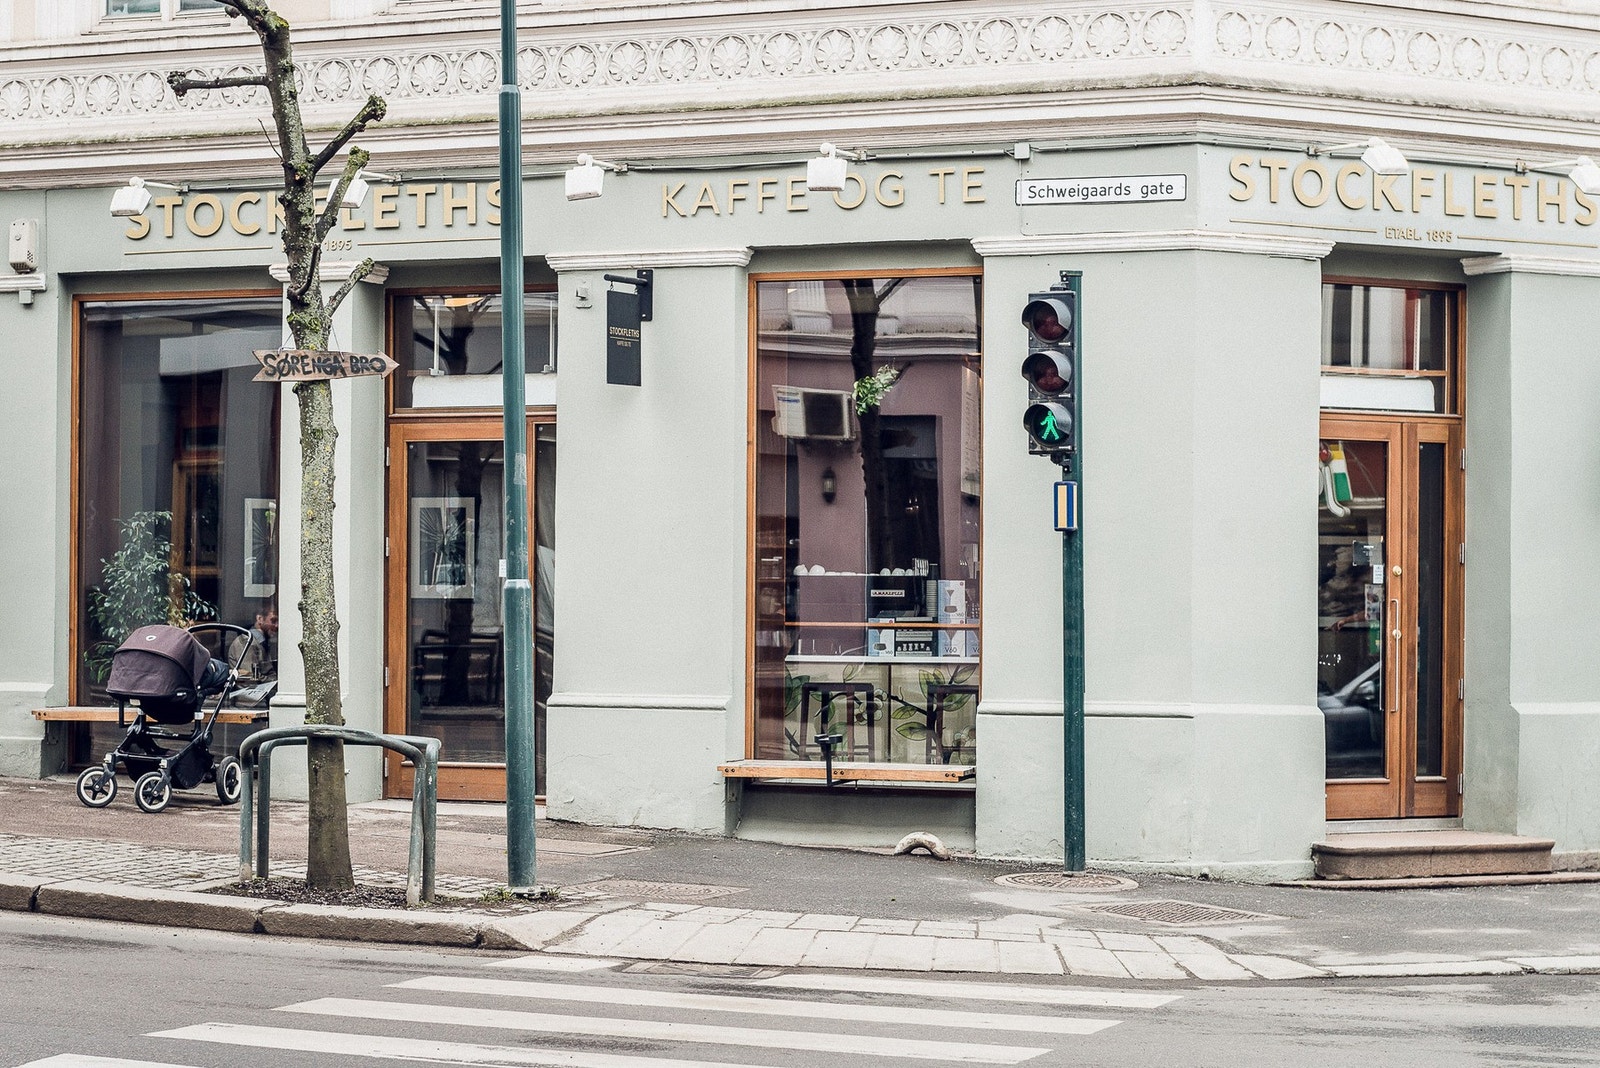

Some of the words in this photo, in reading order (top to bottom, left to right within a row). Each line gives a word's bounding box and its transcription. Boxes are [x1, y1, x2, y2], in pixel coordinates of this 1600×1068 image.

[662, 176, 809, 217] KAFFE
[832, 170, 904, 210] OG
[929, 166, 986, 205] TE
[1028, 183, 1131, 200] Schweigaards
[1140, 182, 1174, 198] gate
[1229, 155, 1598, 225] STOCKFLETHS
[1385, 226, 1422, 241] ETABL.
[1426, 228, 1453, 243] 1895
[324, 240, 352, 251] 1895
[350, 356, 387, 374] BRO
[944, 646, 958, 654] V60
